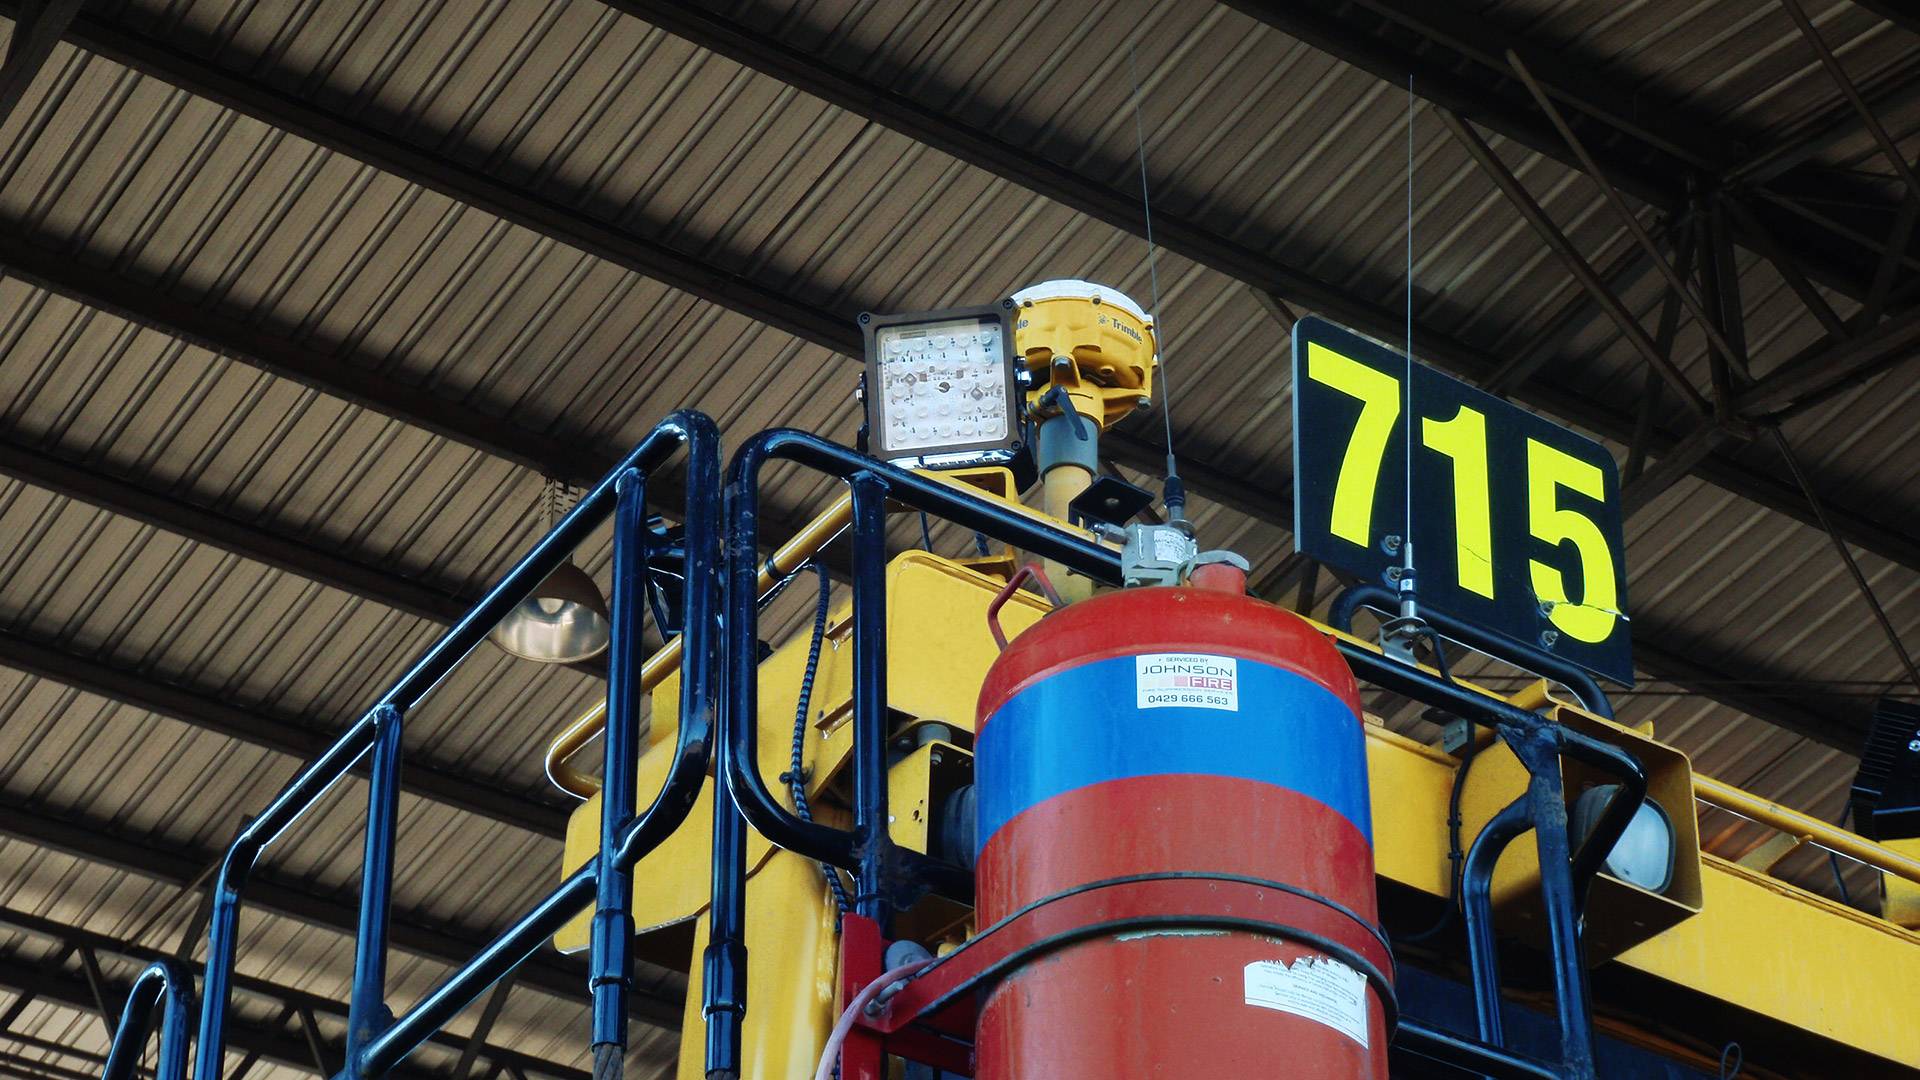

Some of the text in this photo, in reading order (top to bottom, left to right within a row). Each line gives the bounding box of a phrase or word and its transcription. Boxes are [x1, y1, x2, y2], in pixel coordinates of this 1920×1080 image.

[1111, 317, 1143, 343] Trimble
[1308, 341, 1617, 643] 715
[1142, 664, 1233, 677] JOHNSON
[1191, 677, 1232, 690] FIRE
[1148, 694, 1228, 705] 0429 666 563
